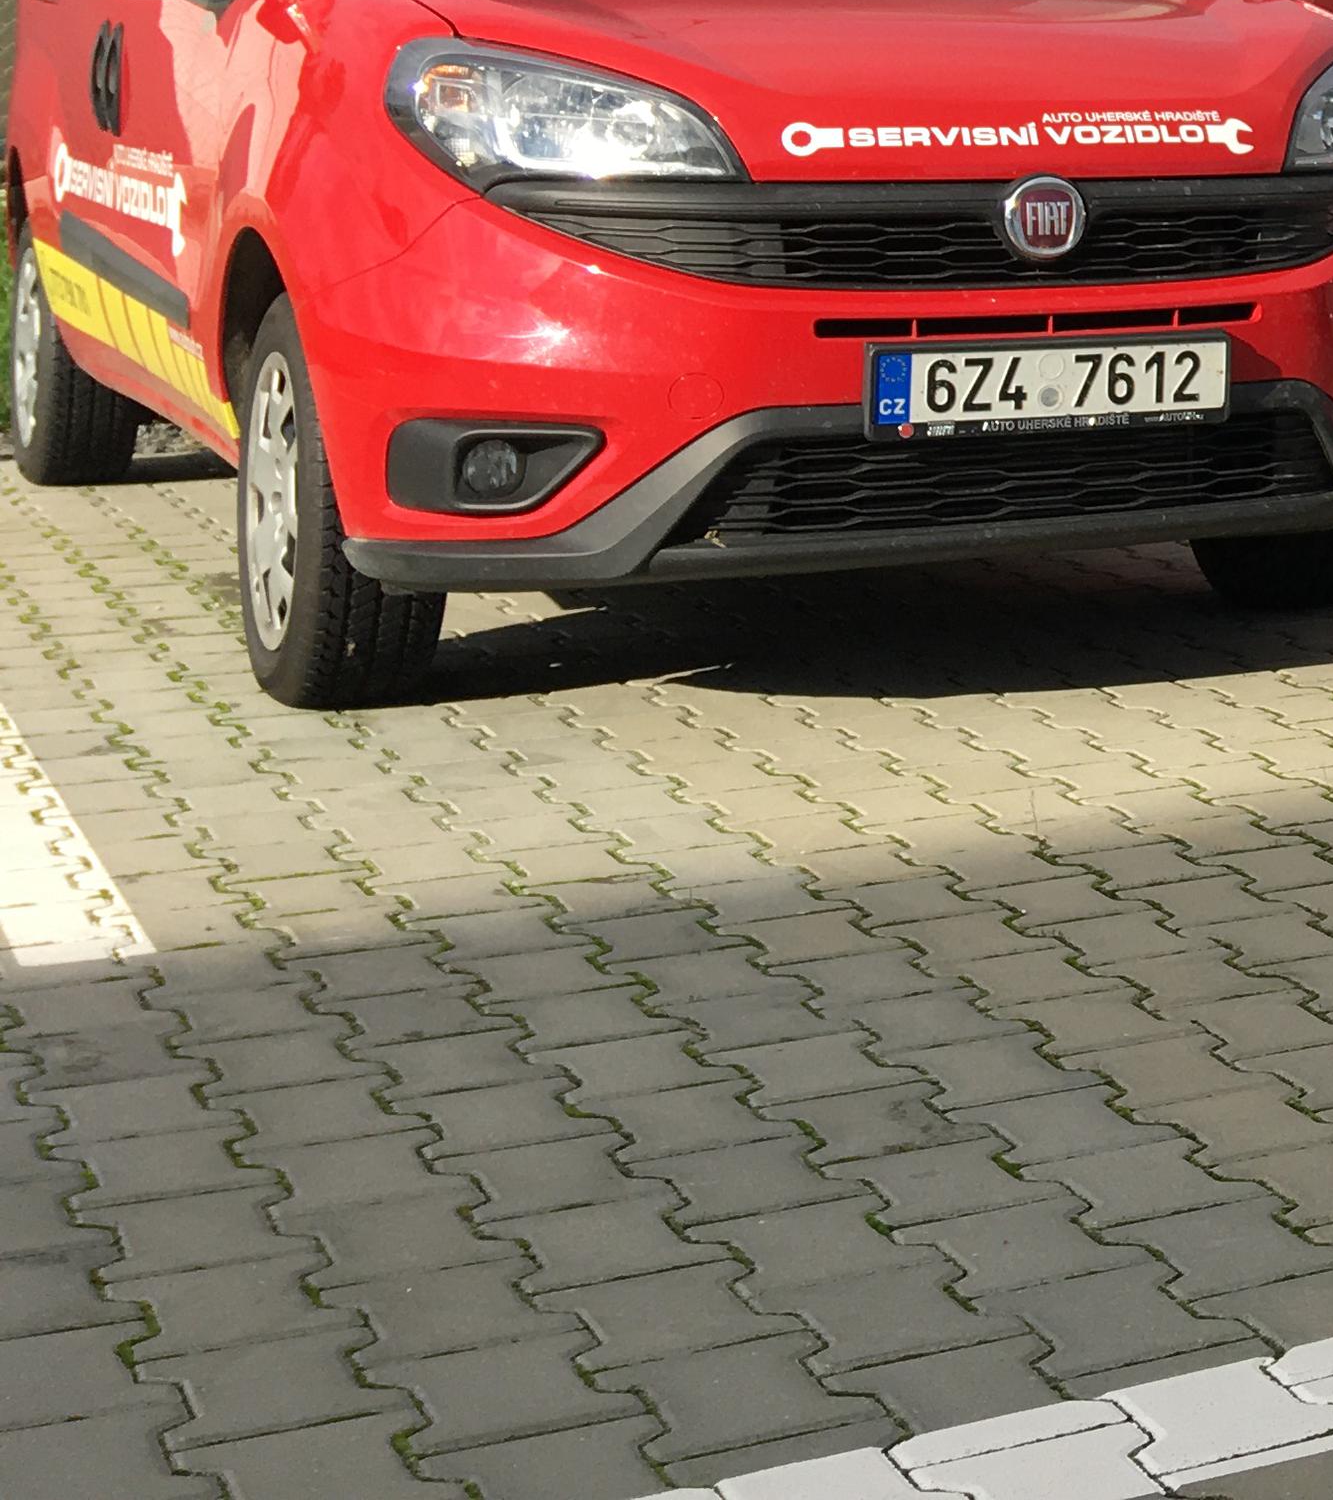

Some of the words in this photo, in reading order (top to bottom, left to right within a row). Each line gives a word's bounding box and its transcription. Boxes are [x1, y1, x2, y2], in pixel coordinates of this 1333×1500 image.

[1041, 112, 1081, 124] AUTO
[1084, 109, 1152, 123] UHERSKÉ
[1154, 108, 1221, 122] HRADIŠTĚ
[848, 121, 1042, 148] SERVISNÍ
[1044, 124, 1204, 146] VOZIDLO
[115, 175, 168, 227] VOZIDLO
[1025, 200, 1071, 237] FIAT
[925, 357, 1028, 414] 6Z4
[1073, 350, 1202, 409] 7612
[878, 399, 906, 417] CZ
[982, 420, 1015, 433] AUTO
[1017, 414, 1072, 431] UHERSKÉ
